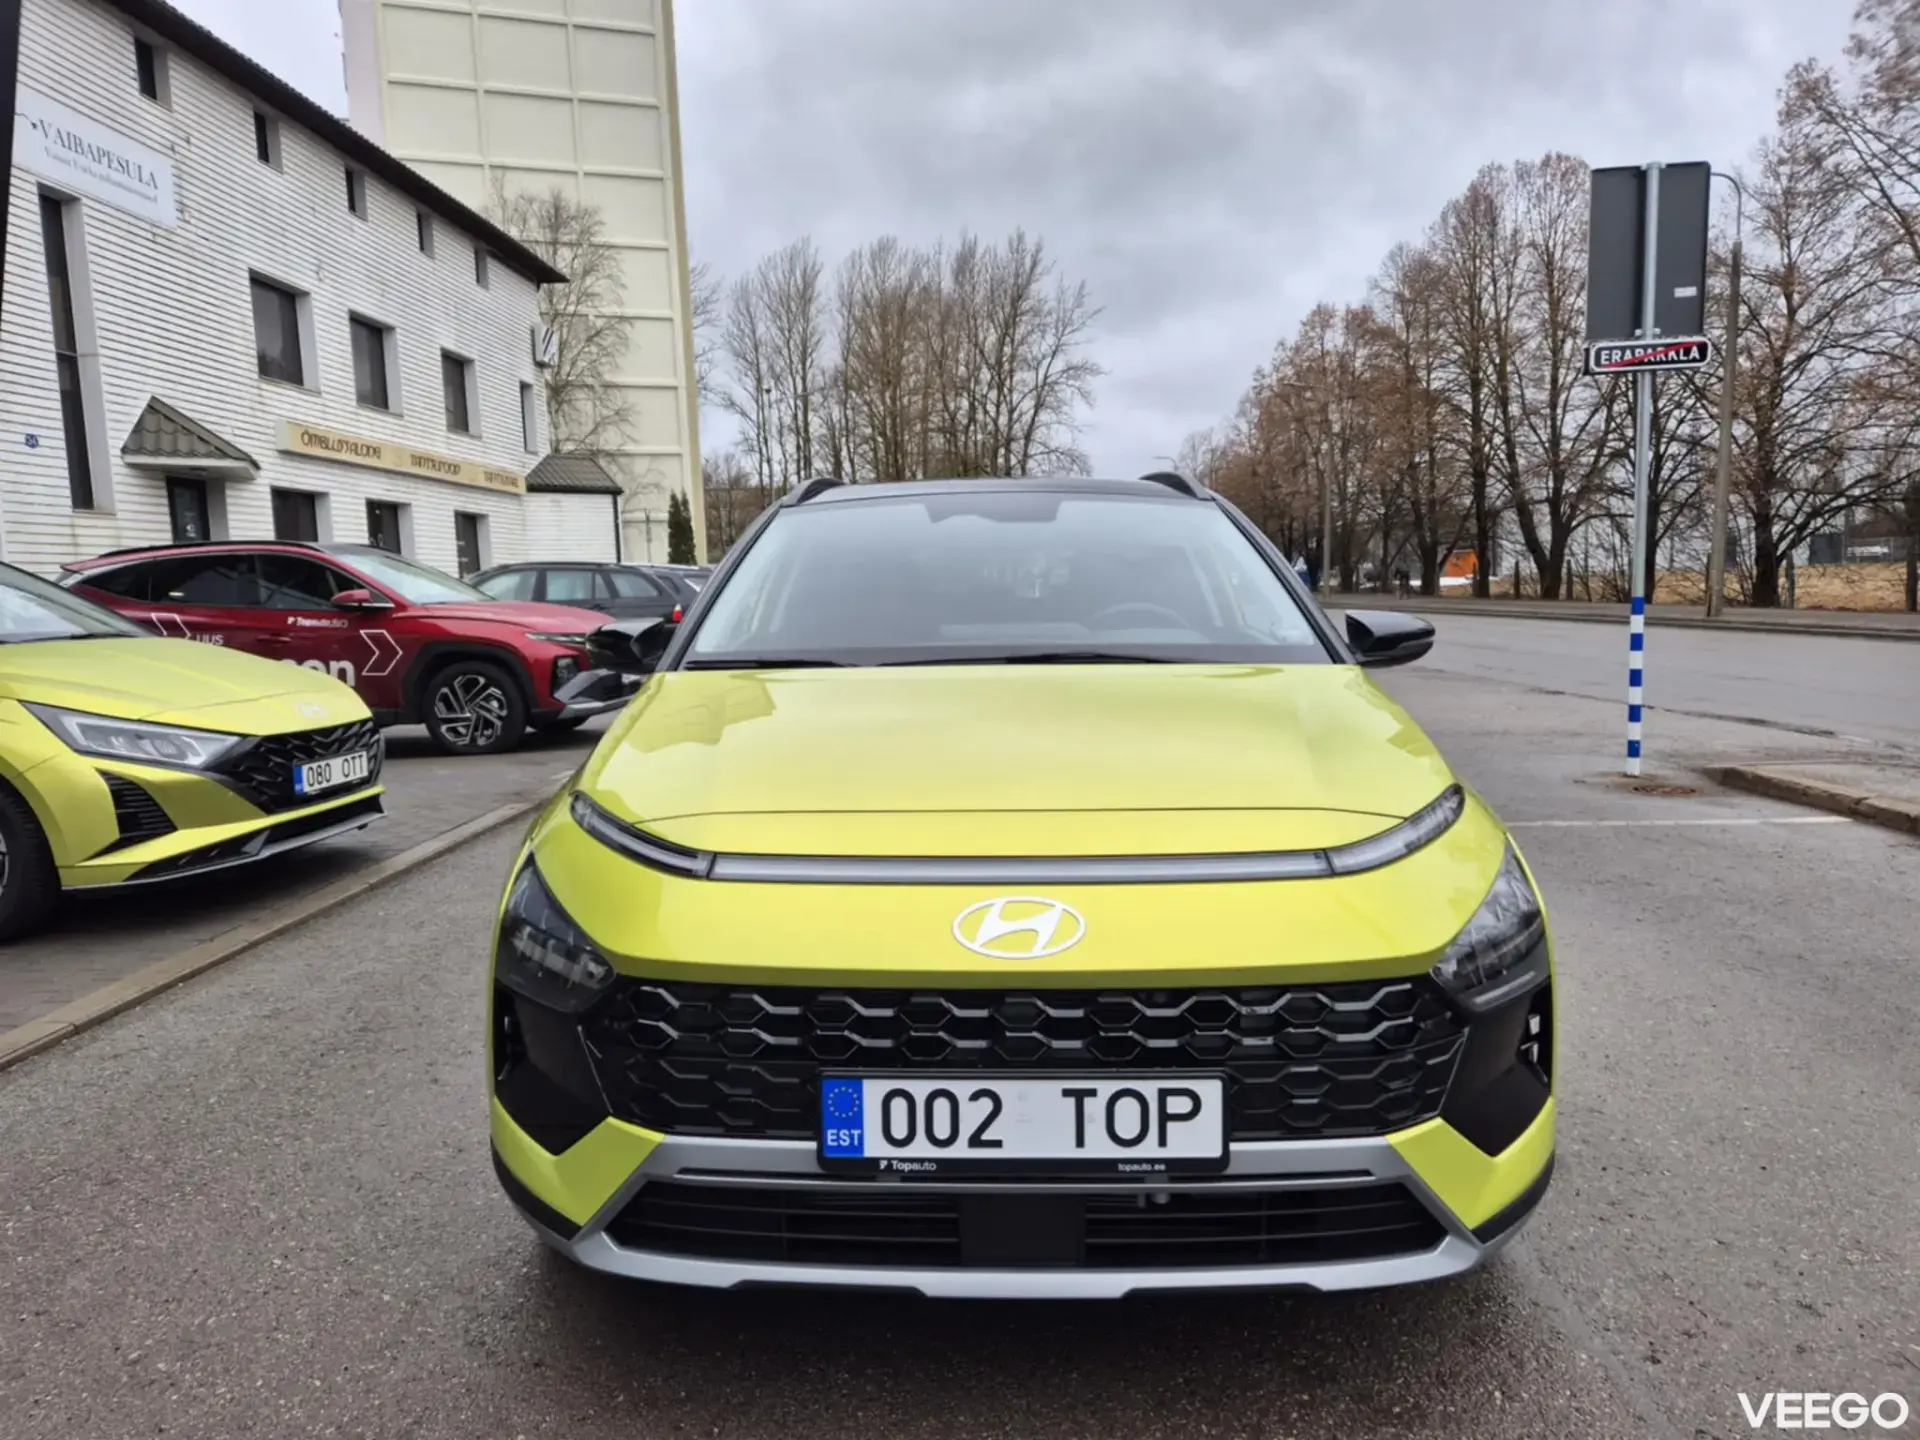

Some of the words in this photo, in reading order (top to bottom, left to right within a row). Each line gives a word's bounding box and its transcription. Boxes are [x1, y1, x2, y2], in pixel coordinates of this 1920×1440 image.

[39, 118, 159, 190] VAIBAPESULA
[307, 762, 332, 787] 080
[341, 754, 364, 778] OTT
[881, 1088, 1003, 1148] 002
[1062, 1088, 1202, 1148] TOP
[827, 1129, 861, 1146] EST
[890, 1160, 937, 1172] Topauto
